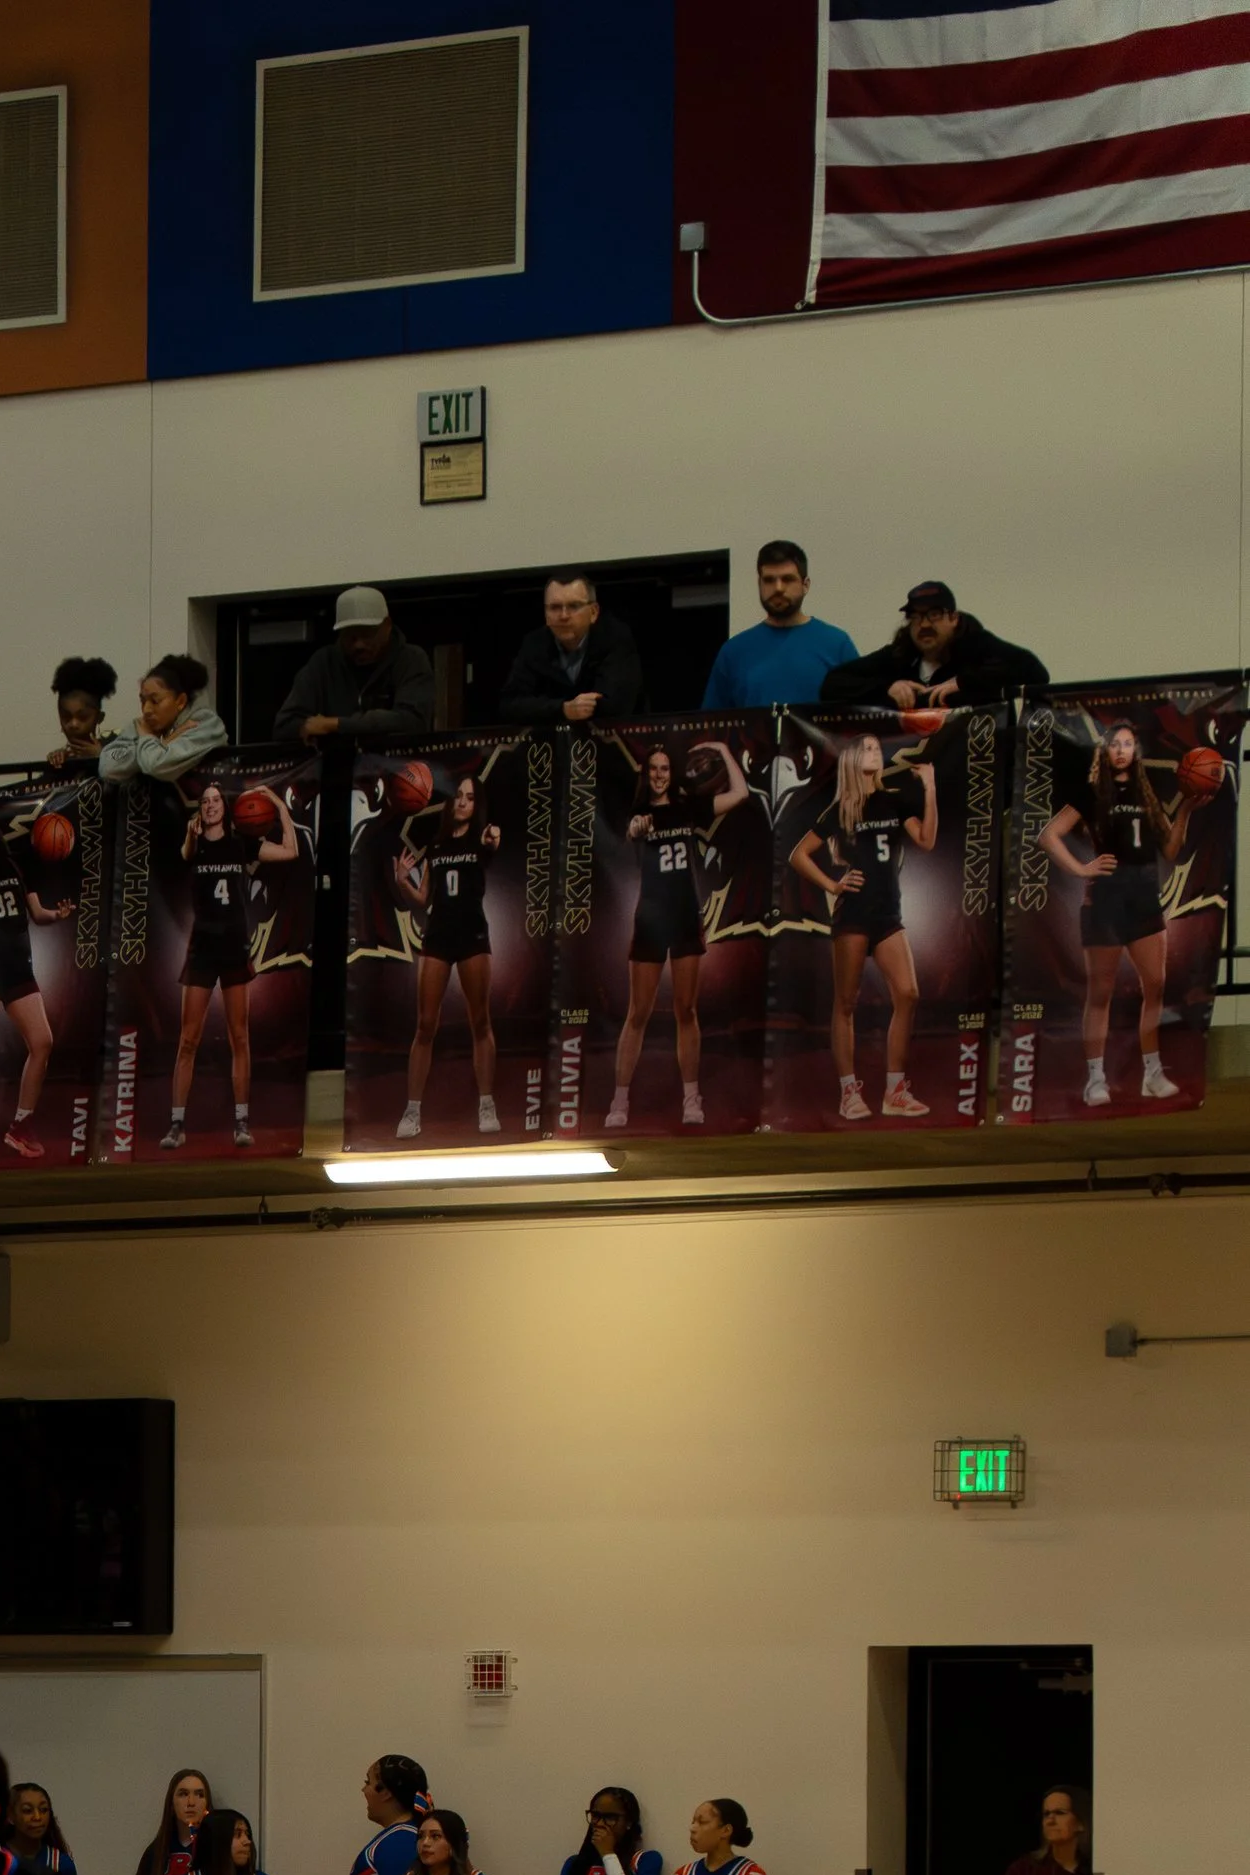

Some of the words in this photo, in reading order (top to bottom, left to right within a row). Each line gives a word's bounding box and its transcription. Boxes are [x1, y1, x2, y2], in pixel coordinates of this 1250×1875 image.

[428, 392, 473, 435] EXIT
[526, 739, 553, 938] SKYHAWKS
[564, 737, 597, 937] SKYHAWKS
[876, 834, 890, 862] 5
[962, 713, 997, 916] SKYHAWKS
[75, 776, 103, 969] SKYHAWKS
[120, 781, 151, 966] SKYHAWKS
[214, 879, 229, 906] 4
[446, 870, 458, 897] 0
[658, 841, 688, 872] 22
[114, 1030, 139, 1152] KATRINA
[525, 1067, 542, 1131] EVIE
[558, 1035, 582, 1129] OLIVIA
[957, 1041, 979, 1115] ALEX
[1011, 1033, 1035, 1113] SARA
[70, 1097, 89, 1157] TAVI
[959, 1450, 1010, 1493] EXIT
